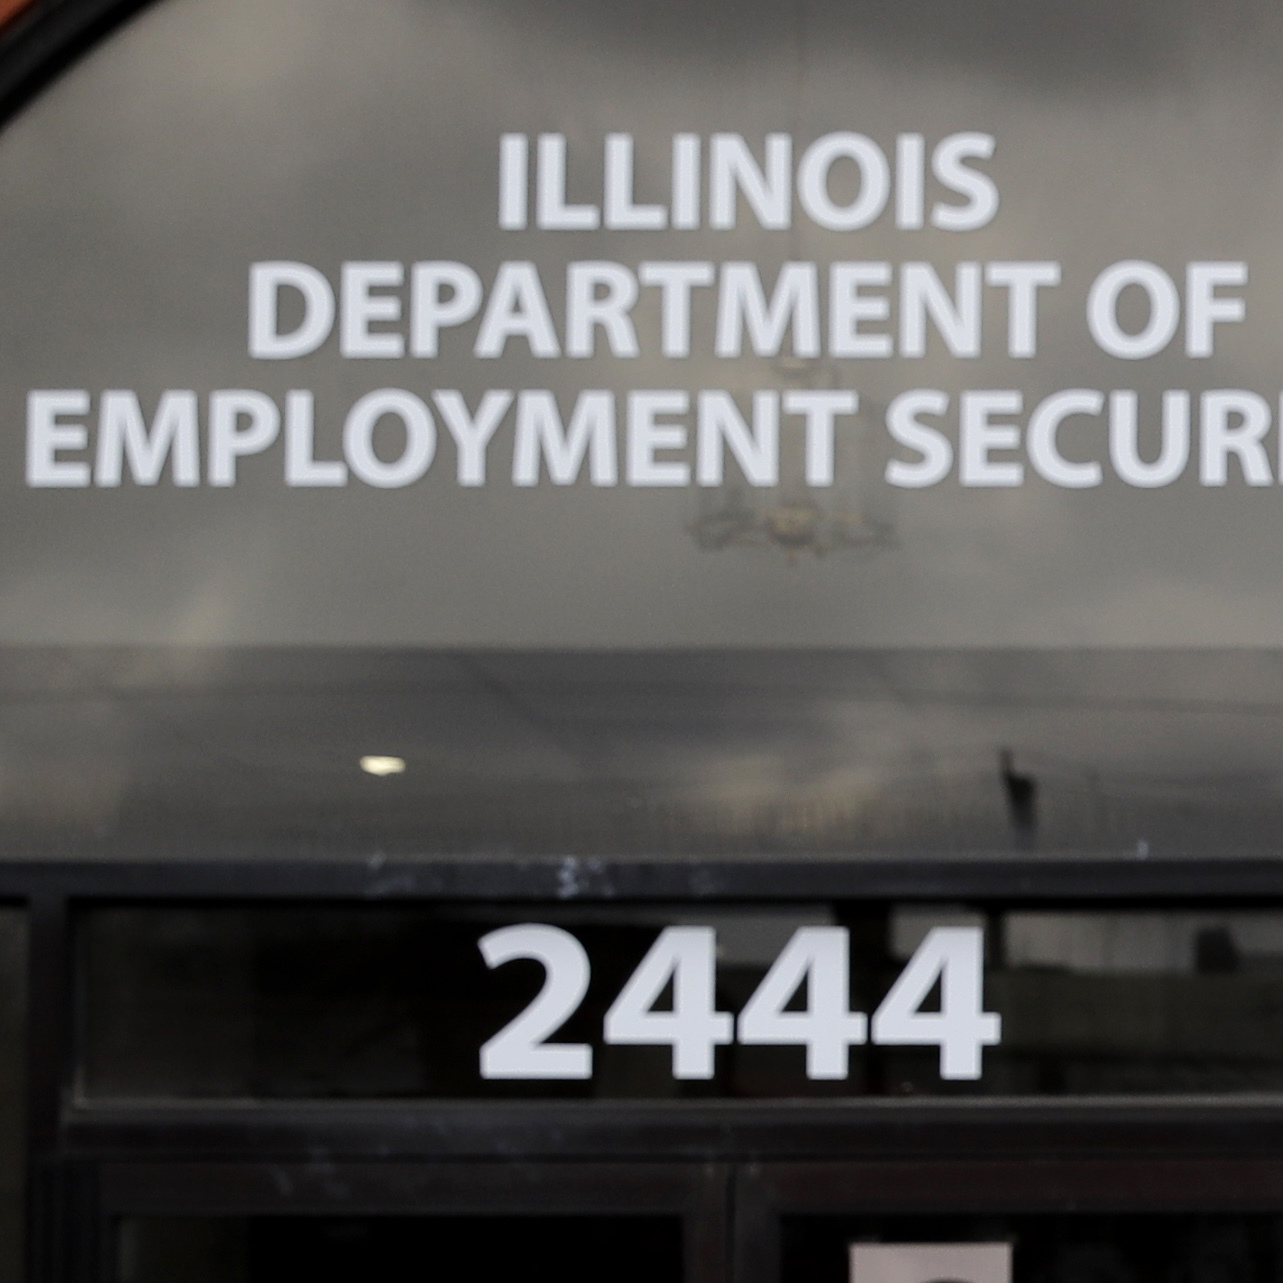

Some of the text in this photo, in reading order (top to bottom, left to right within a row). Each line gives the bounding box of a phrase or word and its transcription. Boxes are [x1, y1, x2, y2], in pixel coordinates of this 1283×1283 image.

[500, 133, 998, 230] ILLINOIS
[250, 260, 1248, 359] DEPARTMENT OF
[28, 390, 858, 487] EMPLOYMENT
[480, 925, 1001, 1080] 2444
